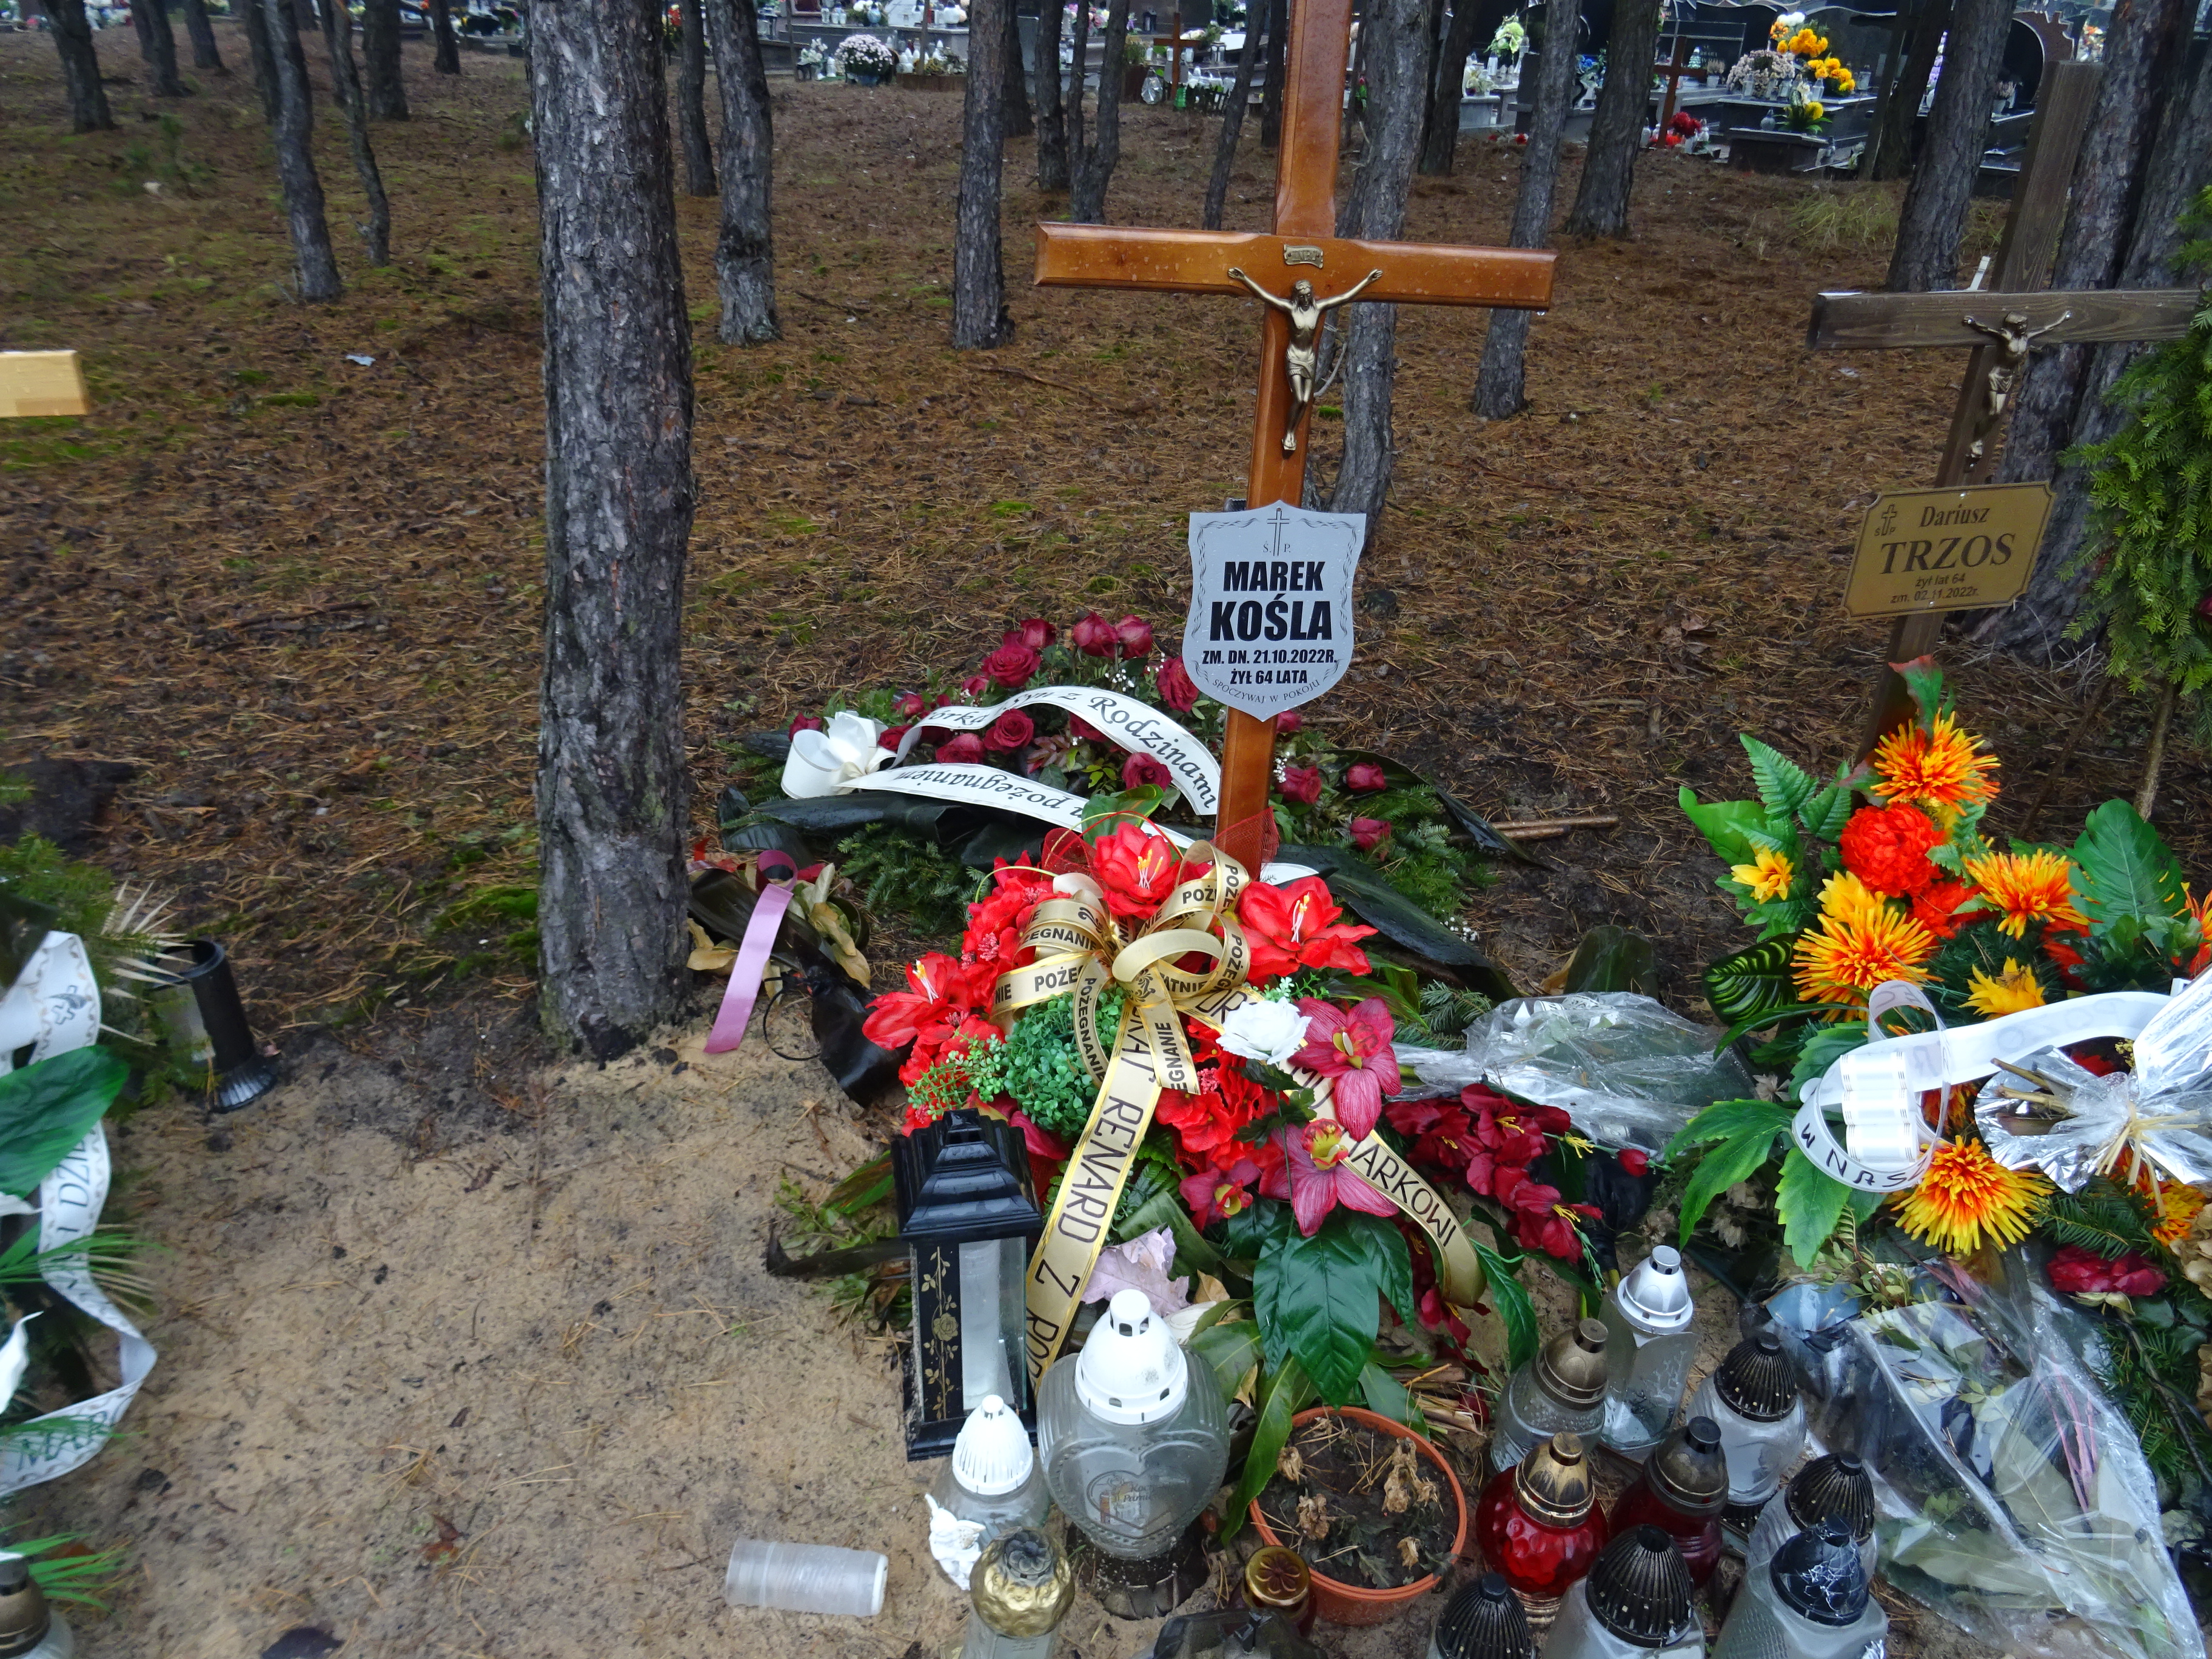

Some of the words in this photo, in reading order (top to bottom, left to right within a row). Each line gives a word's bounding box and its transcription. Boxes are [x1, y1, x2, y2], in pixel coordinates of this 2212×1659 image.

[1919, 504, 1991, 528] Dariusz
[1879, 532, 2016, 574] TRZOS
[1223, 561, 1325, 592] MAREK
[1934, 575, 1949, 585] lat
[1952, 573, 1966, 584] 64
[1890, 594, 1909, 603] zm.
[1209, 593, 1332, 642] KOŚLA
[1202, 650, 1224, 664] ZM.
[1228, 650, 1250, 664] DN.
[1253, 649, 1336, 663] 21.10.2022R.
[1212, 679, 1265, 704] SPOCZYWAJ
[1283, 679, 1320, 700] POKOJU
[1230, 668, 1252, 685] ŻYŁ
[1255, 670, 1273, 684] 64
[1276, 669, 1307, 684] LATA
[928, 710, 990, 725] órka
[1087, 696, 1216, 809] Rodzinami
[894, 769, 1074, 809] pożegnaniem
[1079, 977, 1107, 1083] POŻEGNANIE
[1057, 1095, 1144, 1244] RENARD
[1035, 1258, 1081, 1298] Z
